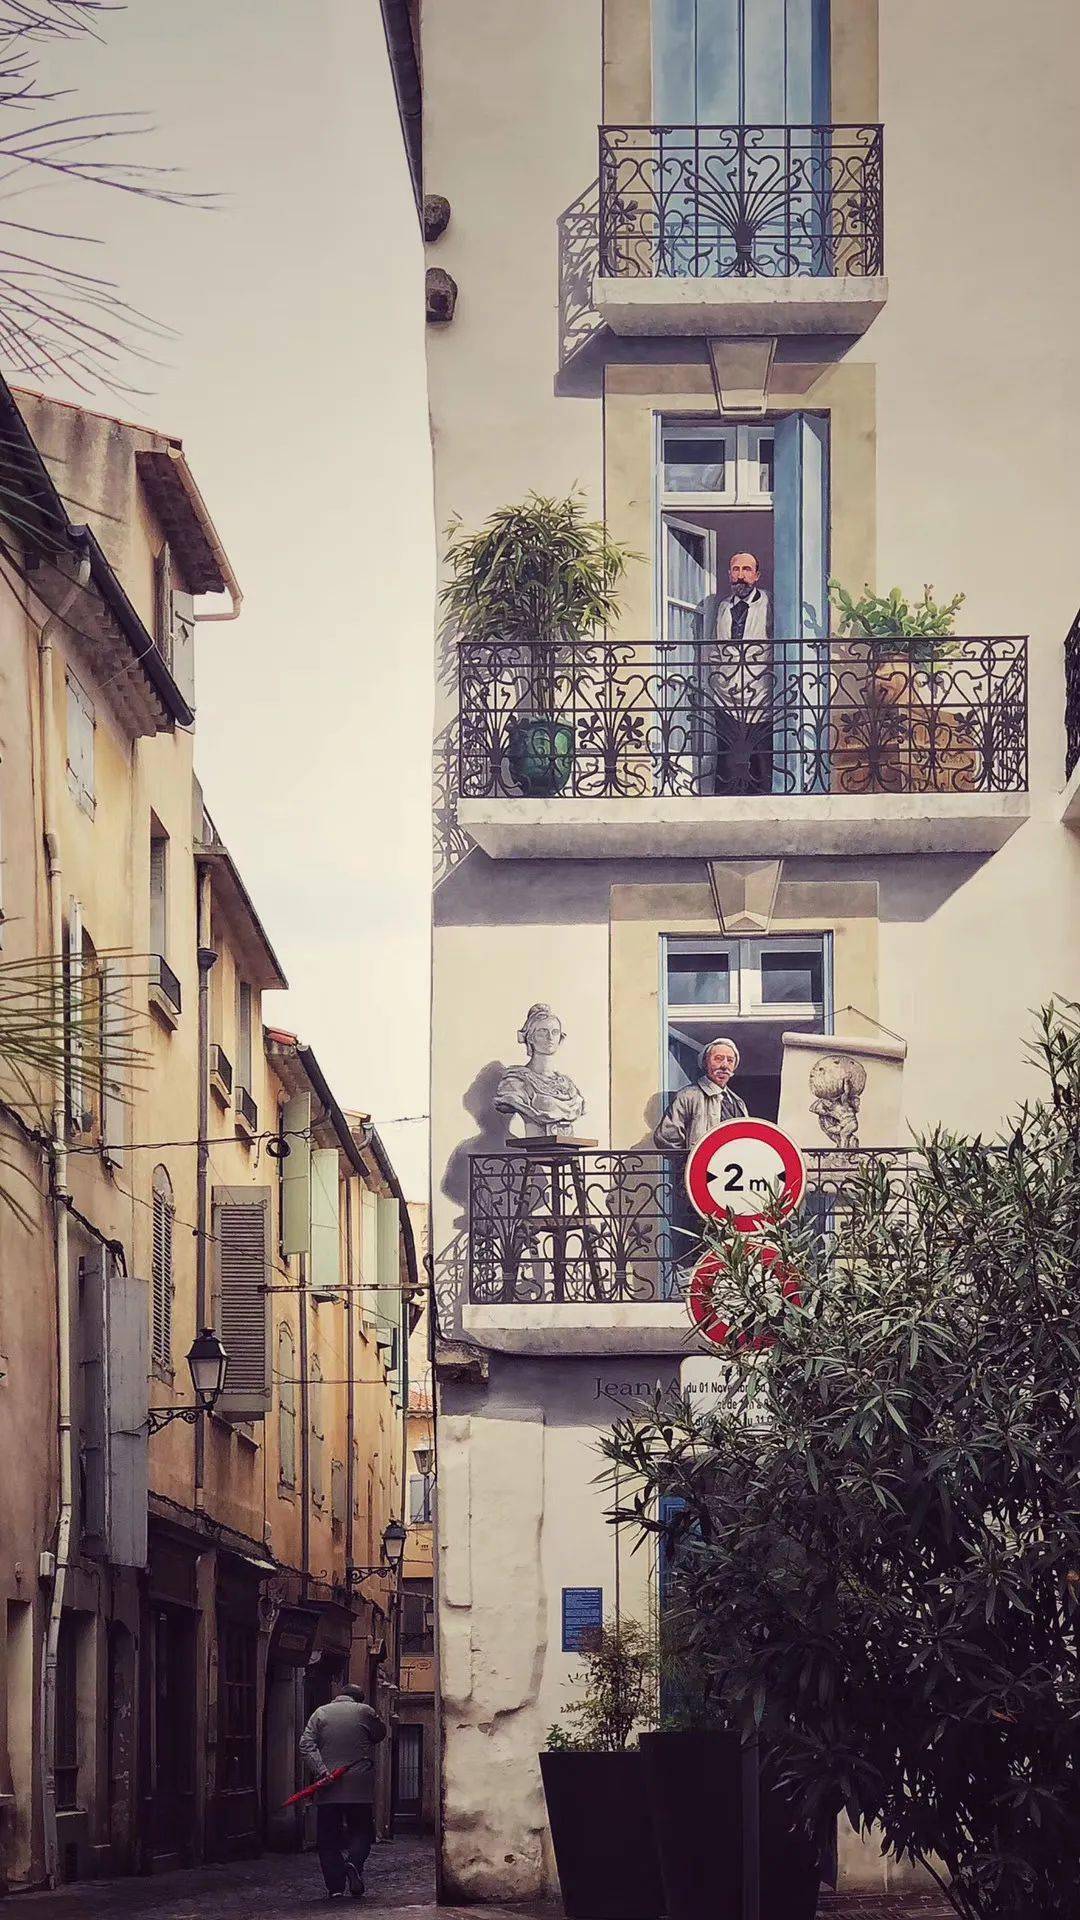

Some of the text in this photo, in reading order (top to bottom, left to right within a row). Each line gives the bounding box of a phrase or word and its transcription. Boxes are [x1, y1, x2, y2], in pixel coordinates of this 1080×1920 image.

[724, 1163, 767, 1192] 2 m
[592, 1377, 651, 1400] Jean
[687, 1382, 697, 1393] du
[700, 1382, 708, 1393] 01
